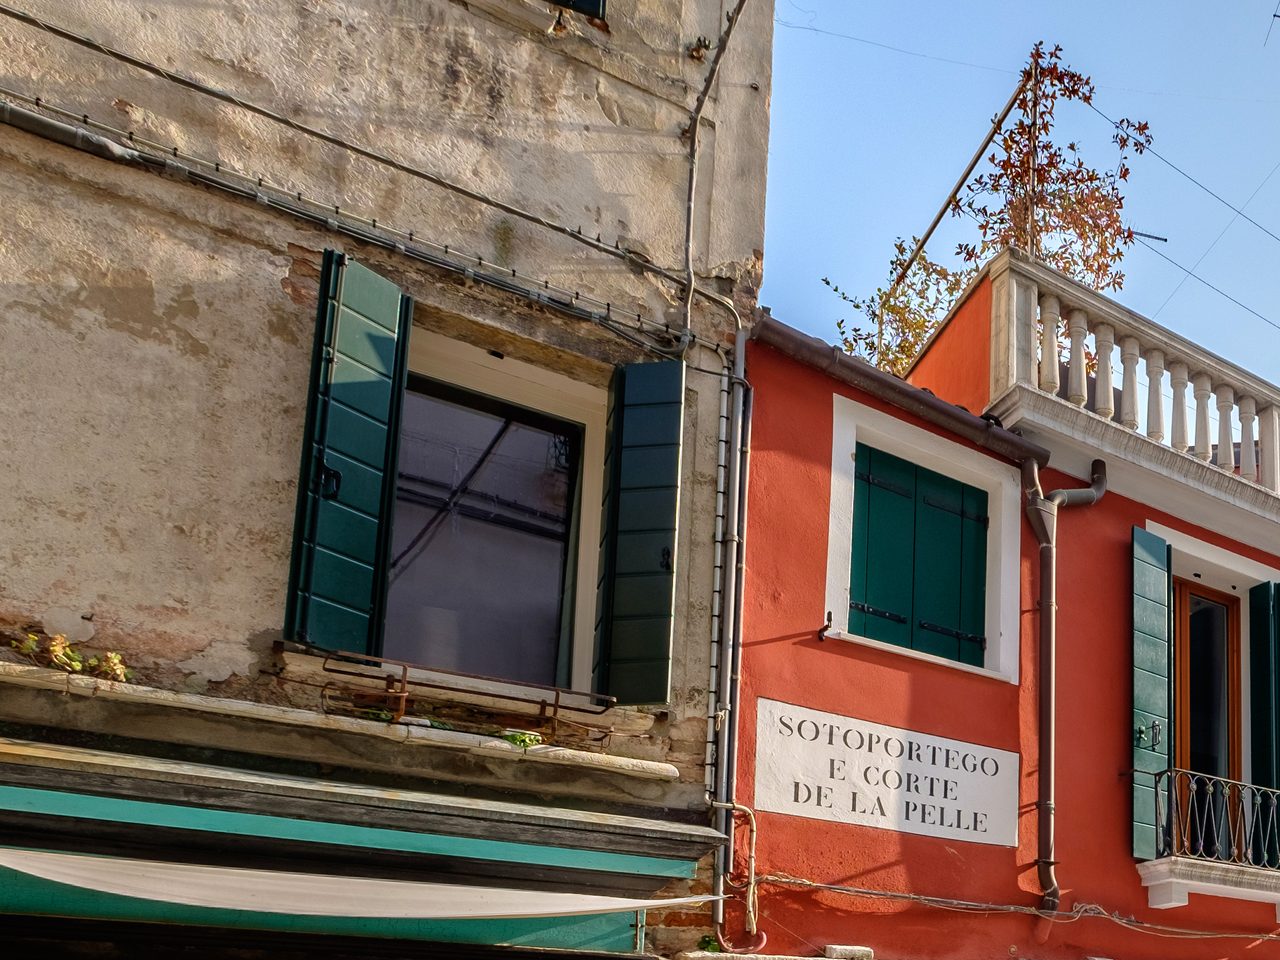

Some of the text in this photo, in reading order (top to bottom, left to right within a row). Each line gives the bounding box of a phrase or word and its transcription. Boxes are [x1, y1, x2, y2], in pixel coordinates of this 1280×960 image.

[778, 714, 1000, 777] SOTOPORTEGO
[828, 758, 959, 801] E CORTE
[792, 781, 988, 833] DE LA PELLE
